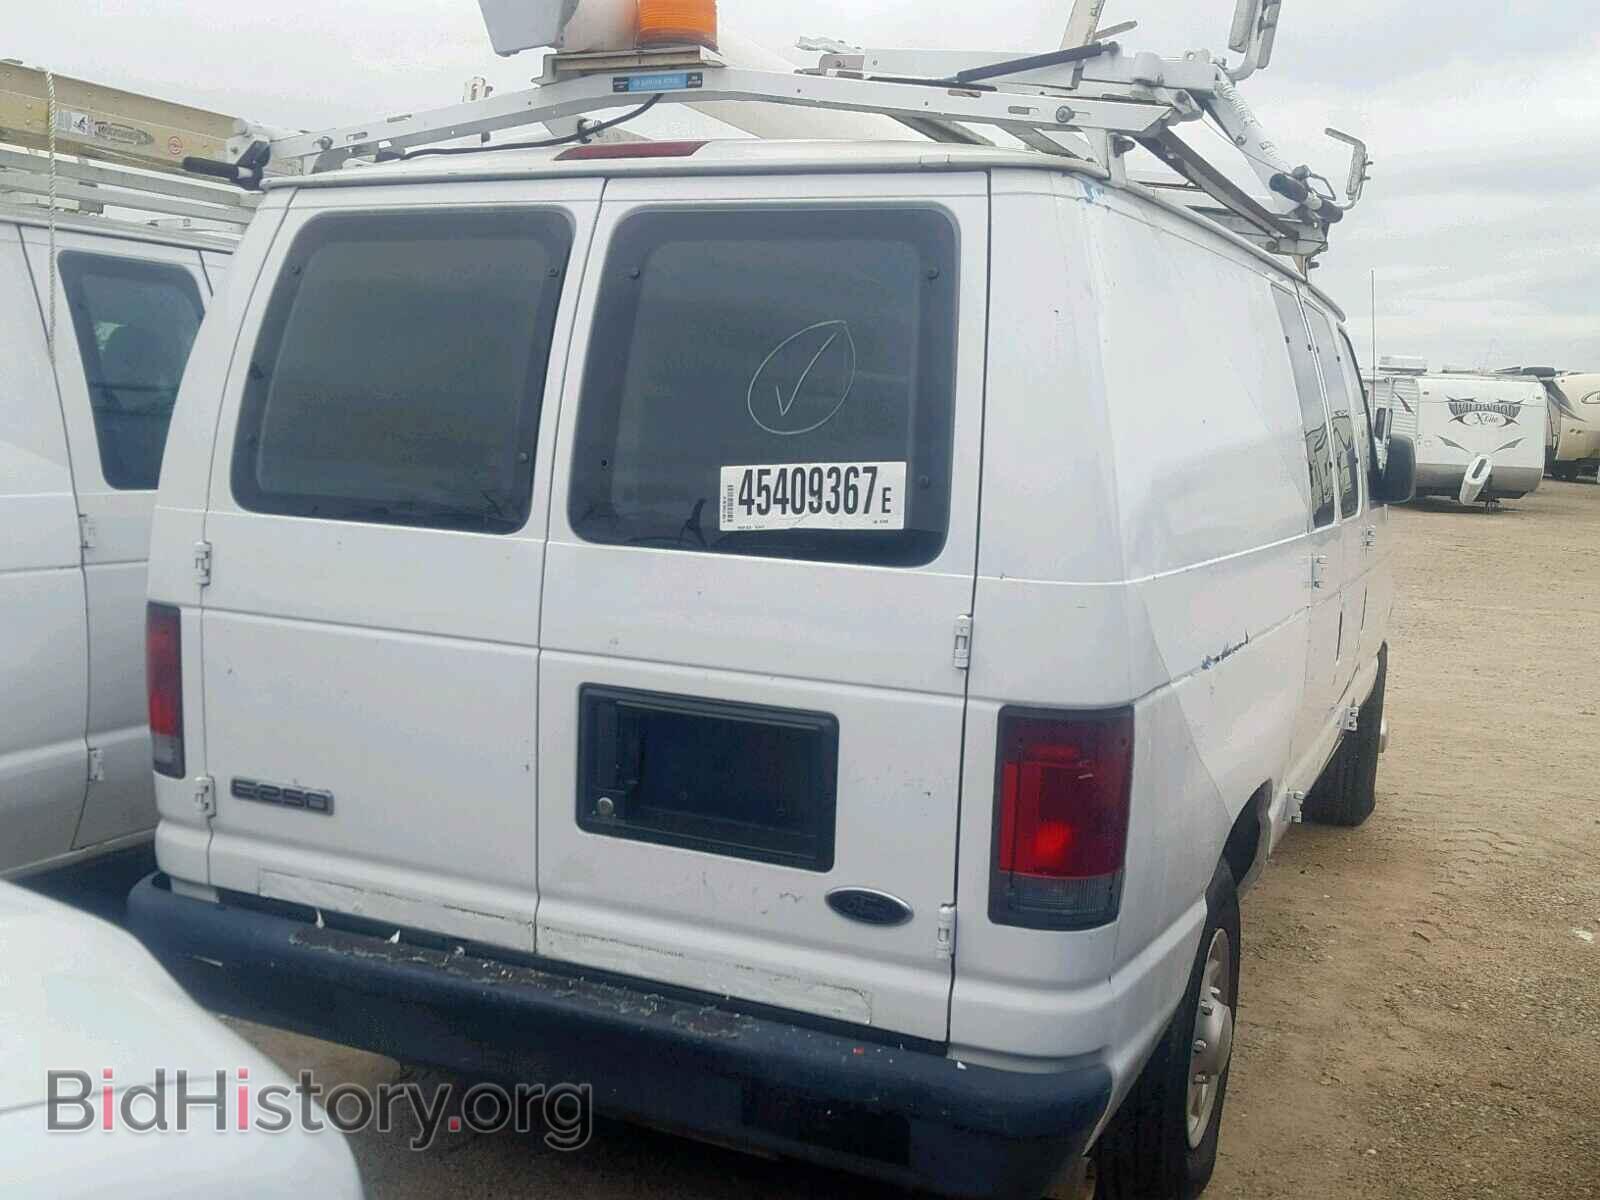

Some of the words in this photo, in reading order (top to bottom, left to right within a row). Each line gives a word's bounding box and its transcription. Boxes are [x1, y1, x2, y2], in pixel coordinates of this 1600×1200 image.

[1451, 402, 1518, 418] WILDWOOD
[738, 466, 878, 516] 45409367
[881, 487, 892, 514] E
